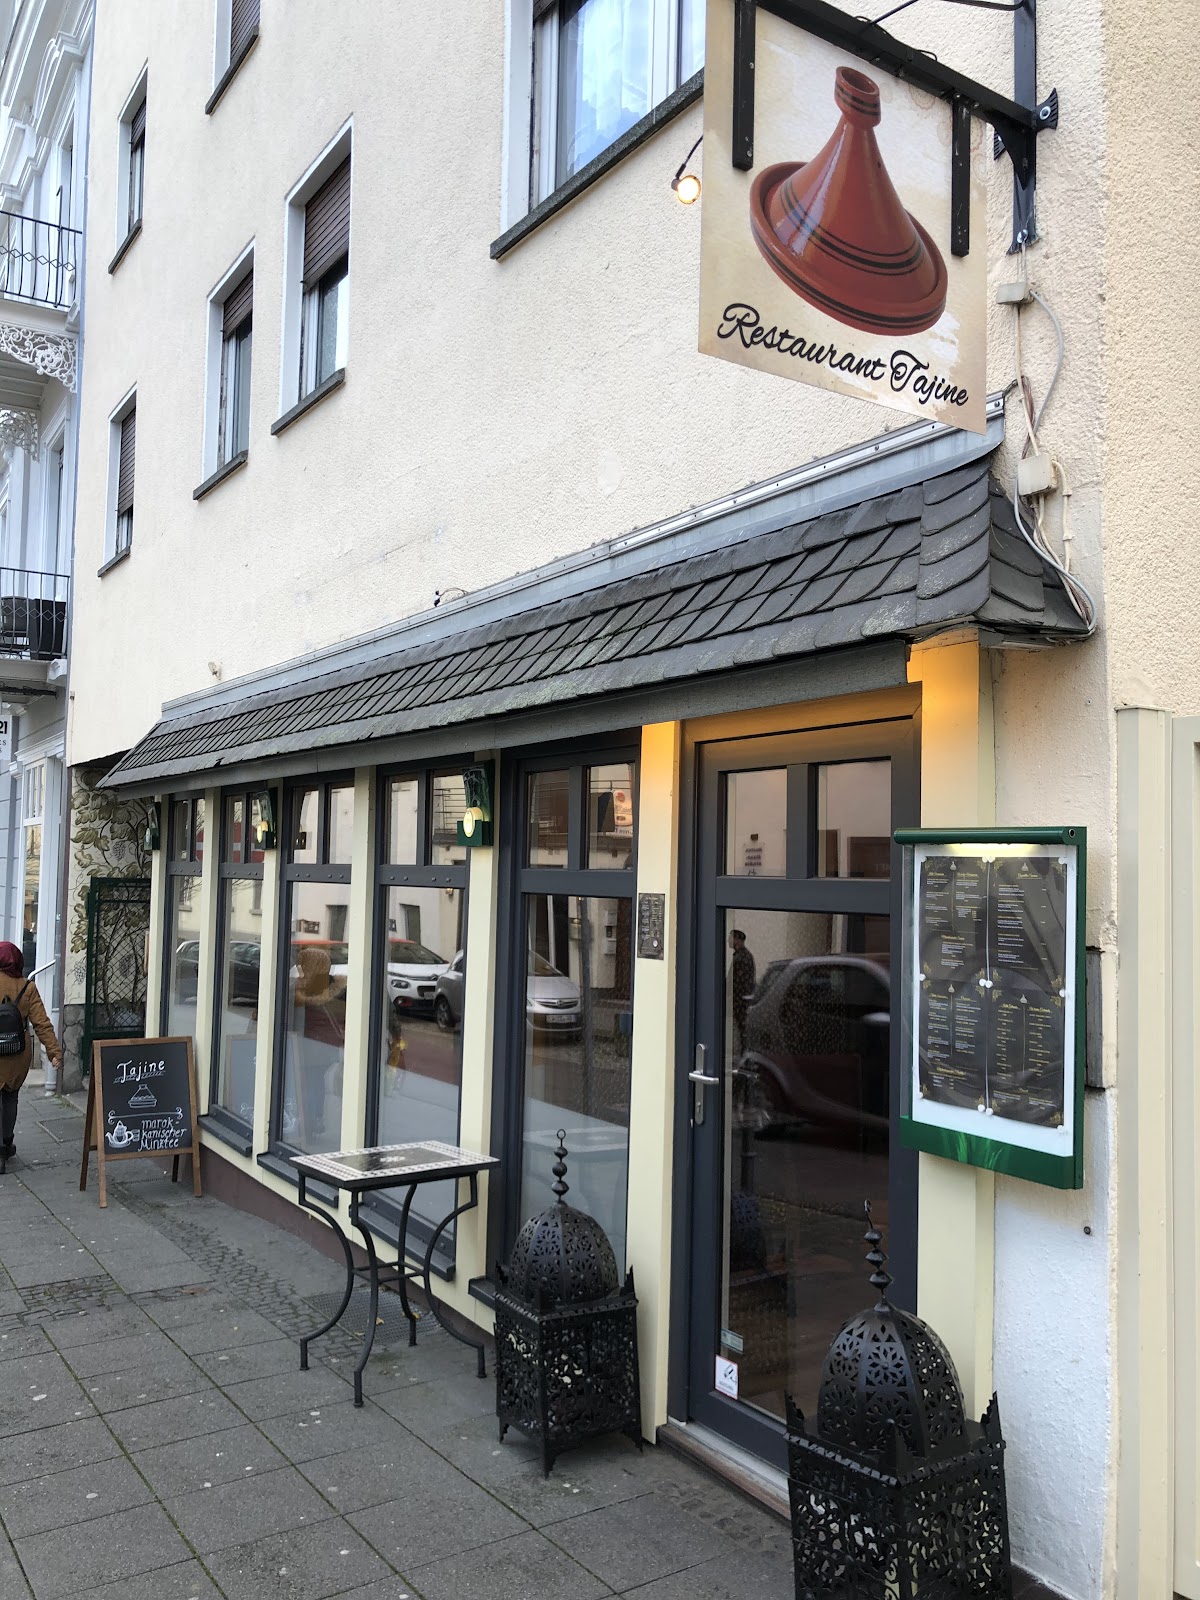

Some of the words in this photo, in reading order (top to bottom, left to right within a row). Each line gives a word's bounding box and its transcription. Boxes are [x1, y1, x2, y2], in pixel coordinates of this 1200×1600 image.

[717, 303, 887, 381] Restaurant
[889, 349, 969, 406] Tajine
[116, 1060, 165, 1083] Tajine
[141, 1128, 187, 1139] kanischer
